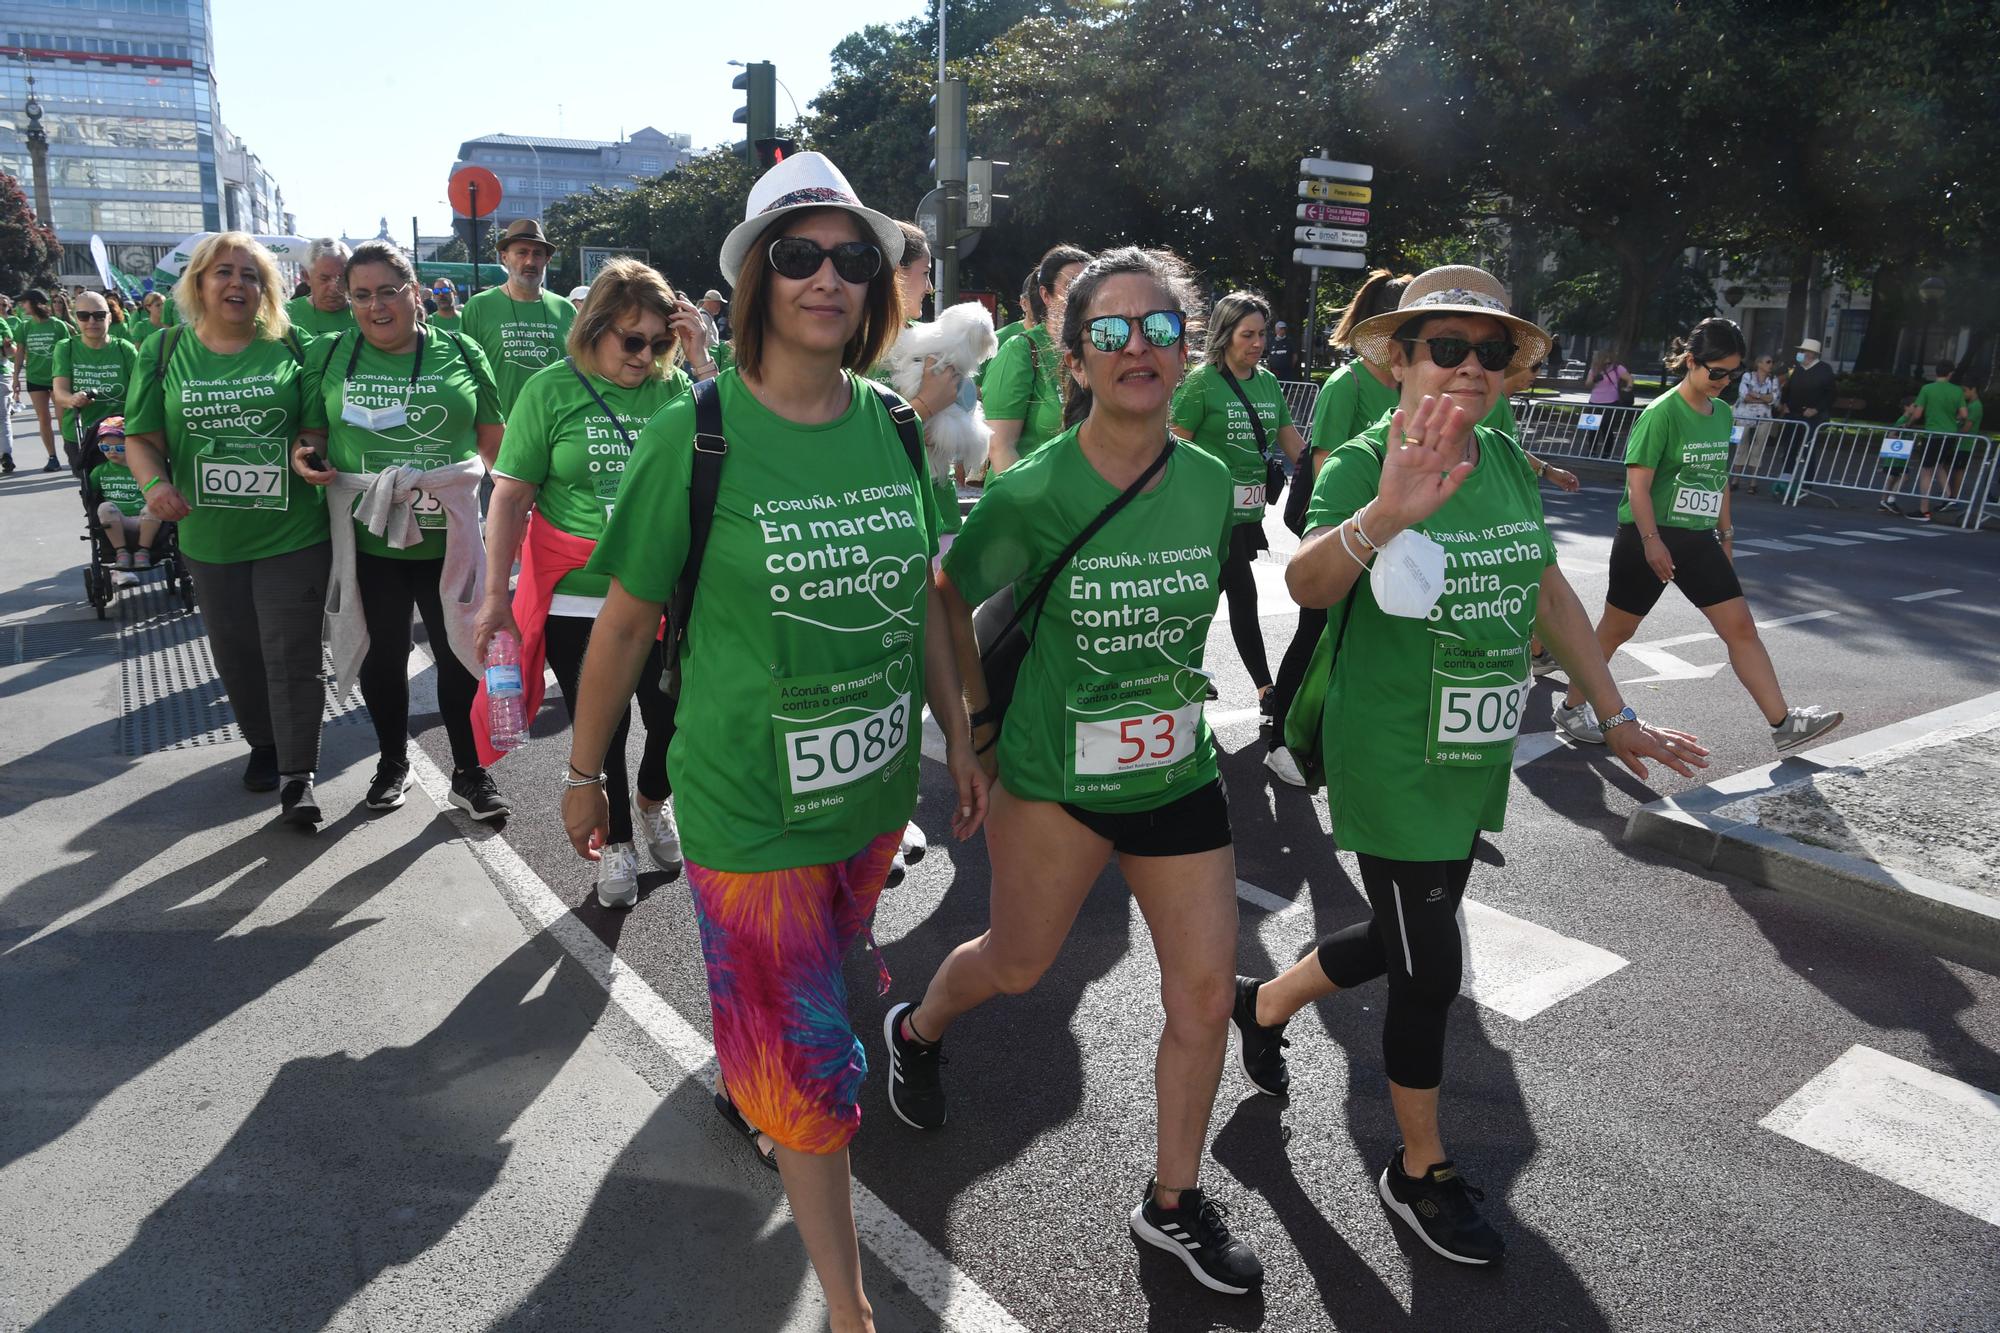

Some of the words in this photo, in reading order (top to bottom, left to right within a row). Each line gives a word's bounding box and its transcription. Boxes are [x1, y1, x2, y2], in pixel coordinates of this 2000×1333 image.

[502, 330, 514, 338] En
[517, 330, 554, 339] marcha
[85, 370, 118, 378] marcha
[182, 390, 202, 402] En
[208, 385, 275, 401] marcha
[347, 381, 366, 392] En
[372, 383, 436, 394] marcha
[345, 395, 401, 407] contra
[182, 403, 241, 417] contra
[592, 413, 631, 423] CORÑA
[1228, 410, 1240, 418] En
[1242, 410, 1275, 419] mcha
[186, 422, 197, 430] o
[586, 426, 609, 439] En
[1683, 452, 1698, 463] En
[589, 461, 600, 472] o
[205, 468, 280, 493] 6027
[753, 504, 765, 517] A
[767, 495, 836, 513] CORUÑA
[843, 491, 860, 505] IX
[861, 482, 912, 502] EDICIÓN
[1677, 490, 1719, 513] 5051
[760, 520, 802, 543] En
[809, 507, 915, 539] marcha
[1423, 530, 1431, 540] A
[1432, 530, 1478, 543] CORUÑA
[1482, 528, 1496, 540] IX
[1497, 520, 1539, 536] EDICIÓN
[766, 544, 869, 574] contra
[1072, 555, 1078, 568] A
[1079, 552, 1142, 571] CORUÑA
[1148, 552, 1160, 565] IX
[1162, 545, 1212, 563] EDICIÓN
[1444, 554, 1457, 569] n
[1461, 541, 1542, 567] marcha
[1070, 576, 1101, 600] En
[1110, 570, 1209, 599] marcha
[1444, 572, 1500, 595] ontra
[770, 584, 790, 602] o
[1071, 604, 1160, 627] contra
[1427, 605, 1443, 621] o
[1077, 634, 1089, 650] o
[1453, 647, 1485, 657] Coruña
[1444, 659, 1476, 668] contra
[782, 688, 790, 699] A
[791, 683, 829, 697] Coruña
[831, 683, 846, 693] en
[848, 672, 883, 690] marcha
[1077, 684, 1084, 692] A
[1085, 682, 1119, 692] Coruña
[1121, 680, 1132, 689] en
[1135, 673, 1169, 686] marcha
[782, 697, 820, 711] contra
[832, 690, 868, 705] cancro
[1076, 694, 1108, 705] contra
[1120, 688, 1152, 699] cancro
[1793, 719, 1808, 732] N
[794, 704, 905, 782] 5088
[1118, 714, 1175, 764] 53
[1462, 752, 1482, 760] Maio
[1101, 782, 1120, 791] Maio
[794, 805, 805, 813] 29
[808, 801, 820, 810] de
[822, 796, 844, 807] Maio
